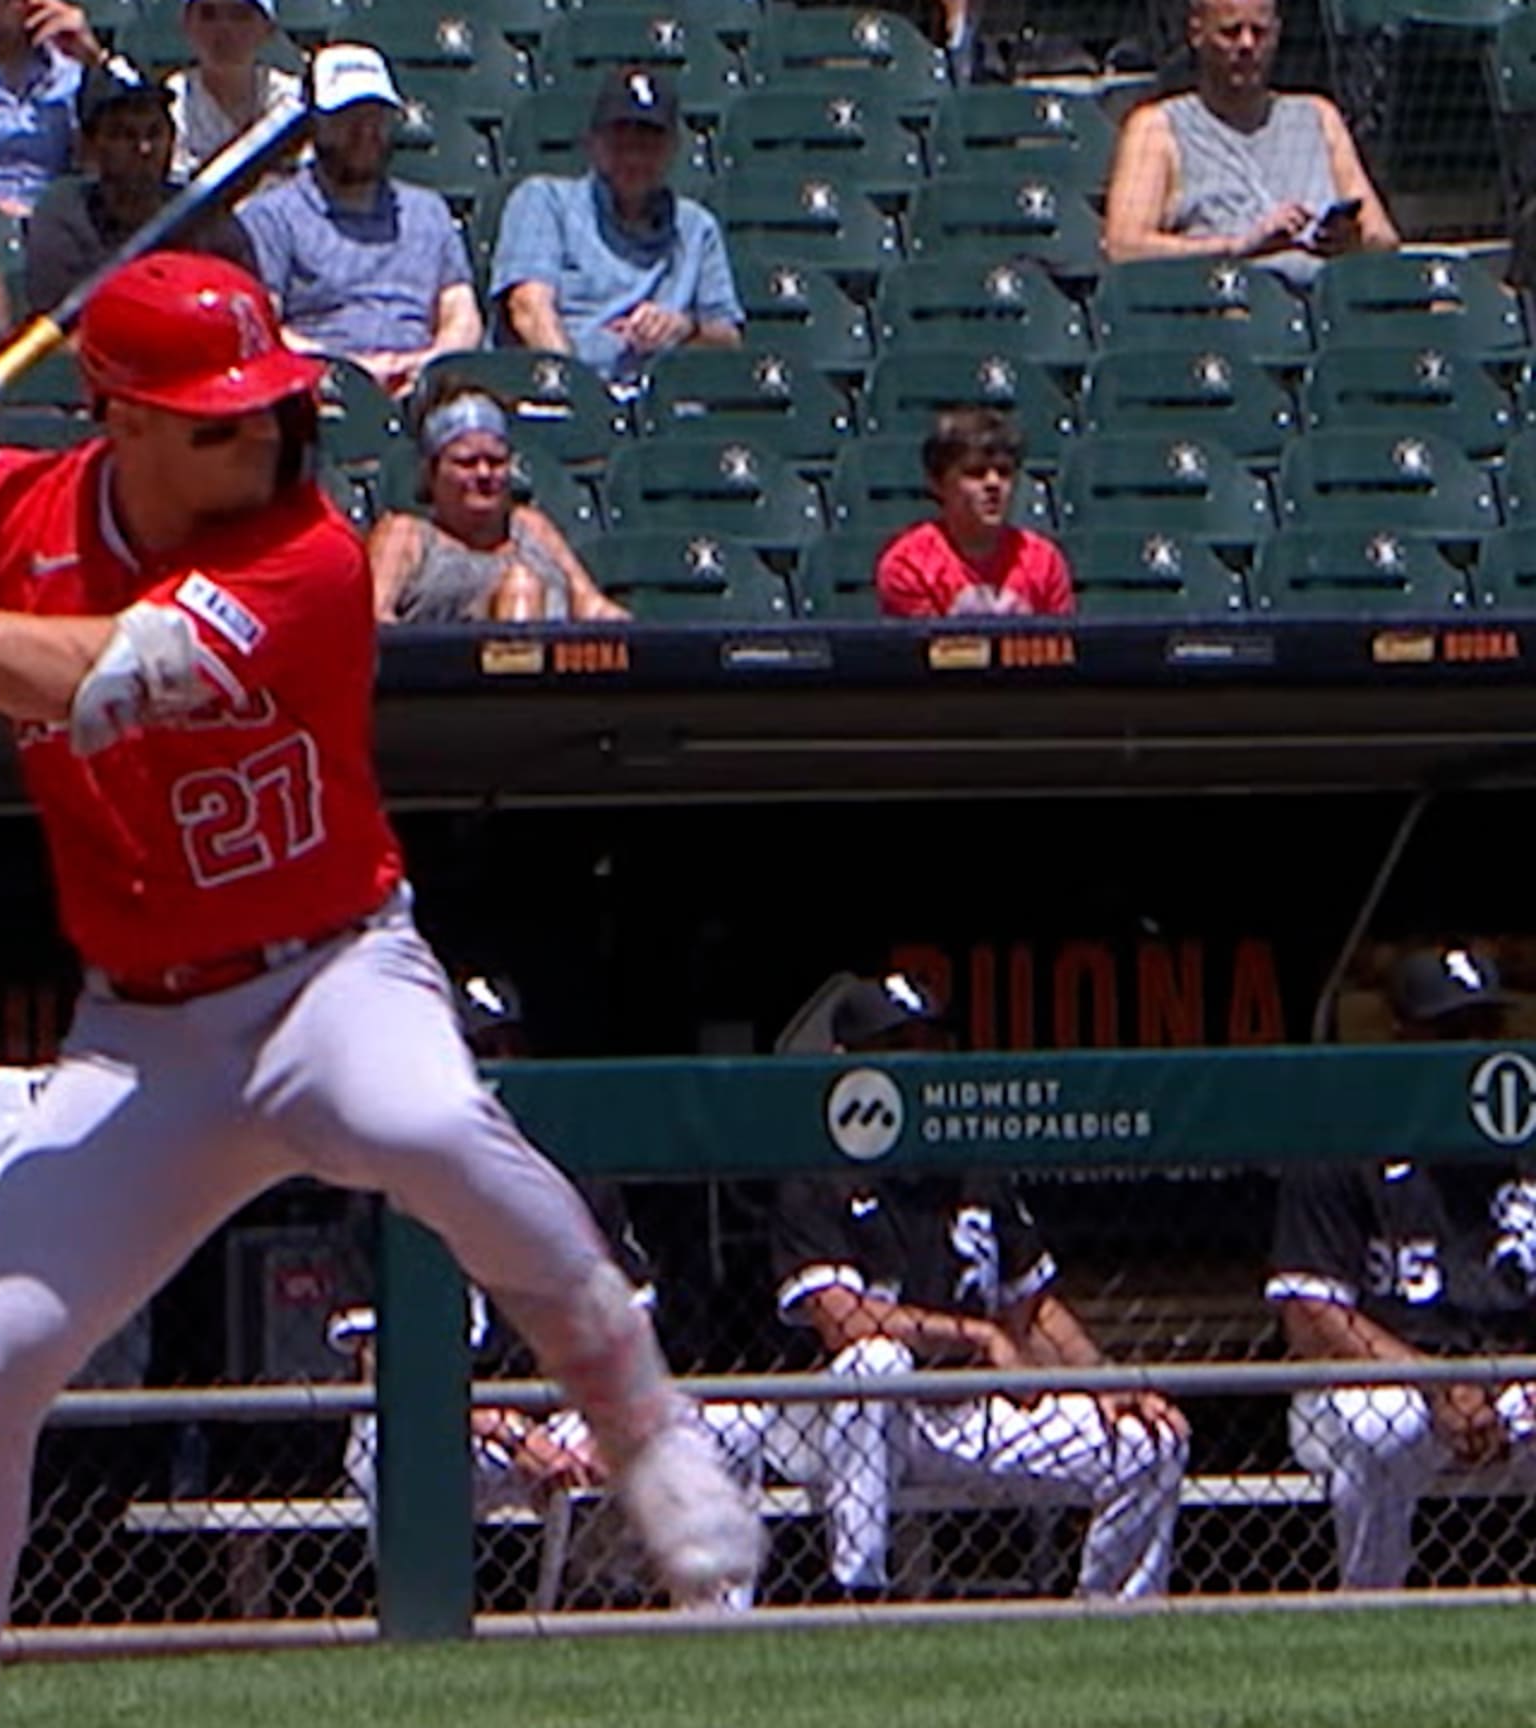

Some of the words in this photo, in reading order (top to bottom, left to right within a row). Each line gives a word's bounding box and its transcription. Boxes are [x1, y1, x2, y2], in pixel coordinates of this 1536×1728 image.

[172, 730, 326, 889] 27
[923, 1080, 1061, 1107] MIDWEST
[922, 1109, 1153, 1143] ORTHOPAEDICS
